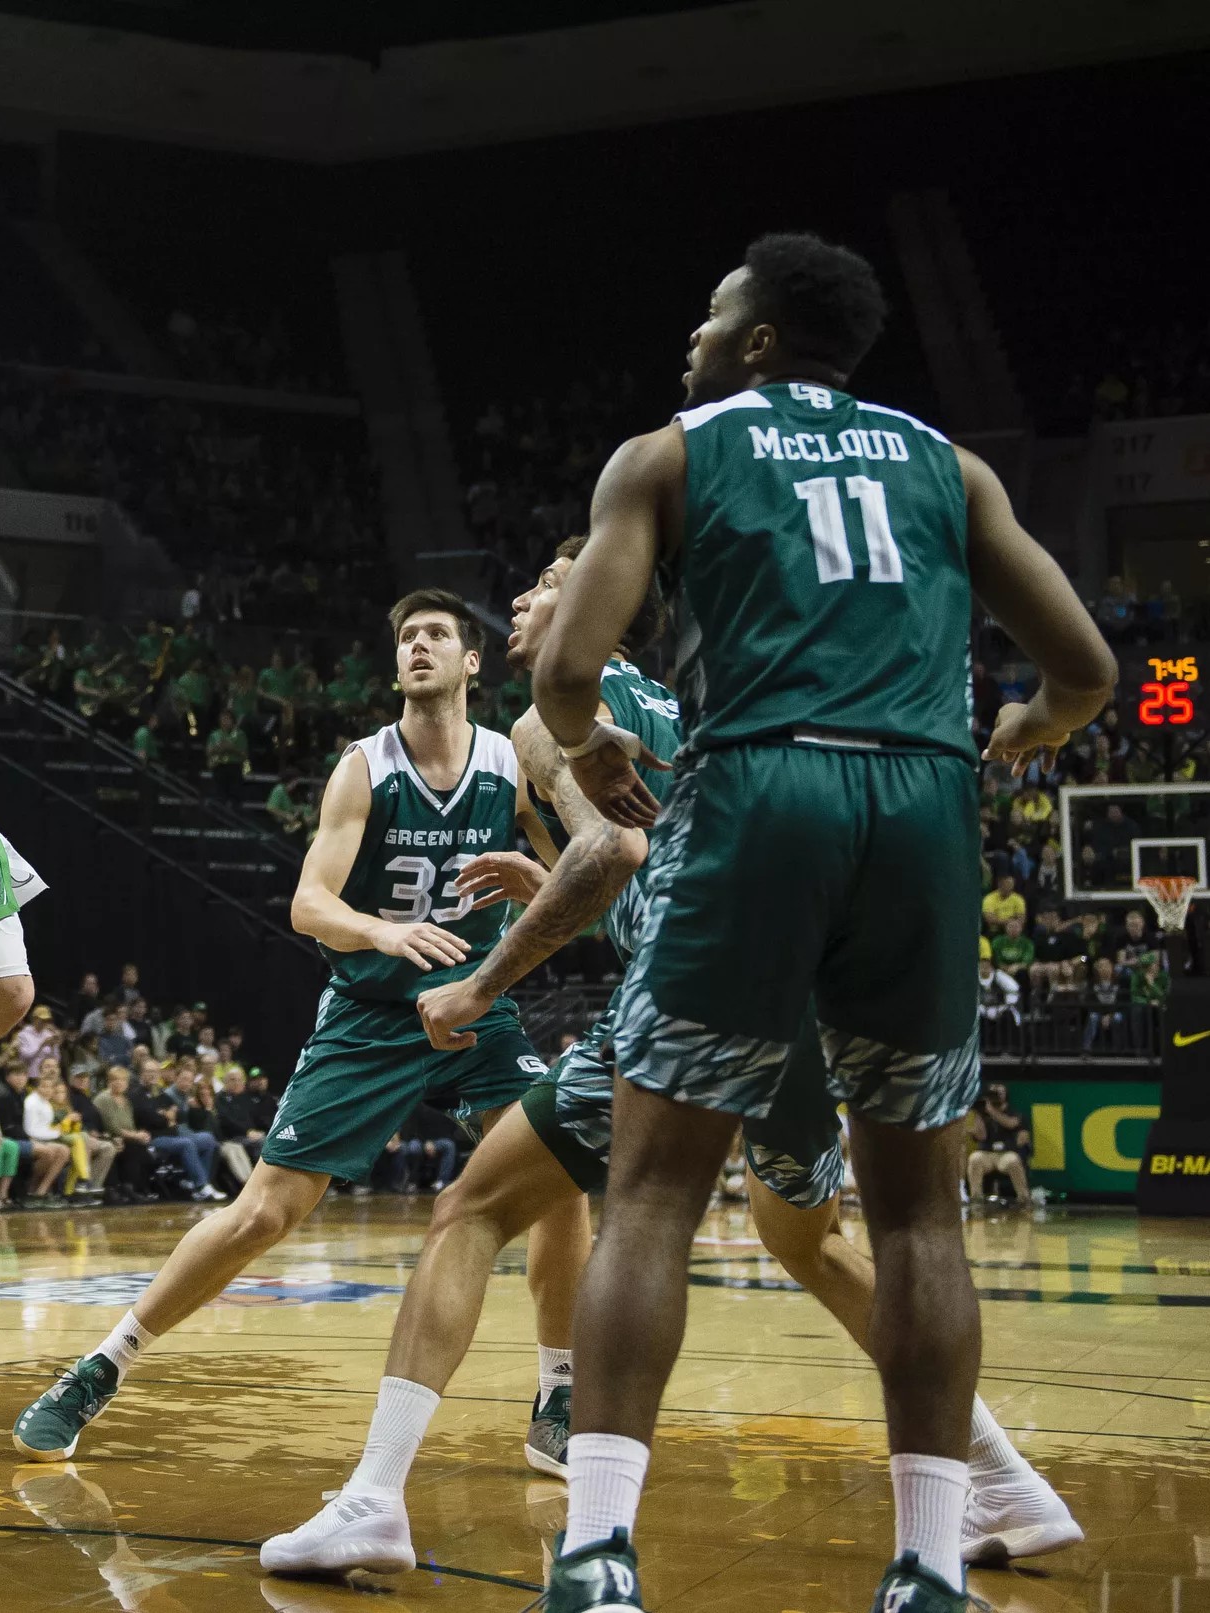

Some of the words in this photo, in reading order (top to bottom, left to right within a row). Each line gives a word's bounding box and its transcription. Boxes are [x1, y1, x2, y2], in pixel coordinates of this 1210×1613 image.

[747, 425, 910, 463] McCLOUD
[793, 475, 904, 584] 11
[1147, 656, 1199, 682] 7:45
[1139, 681, 1194, 725] 25
[384, 828, 453, 846] GREEN
